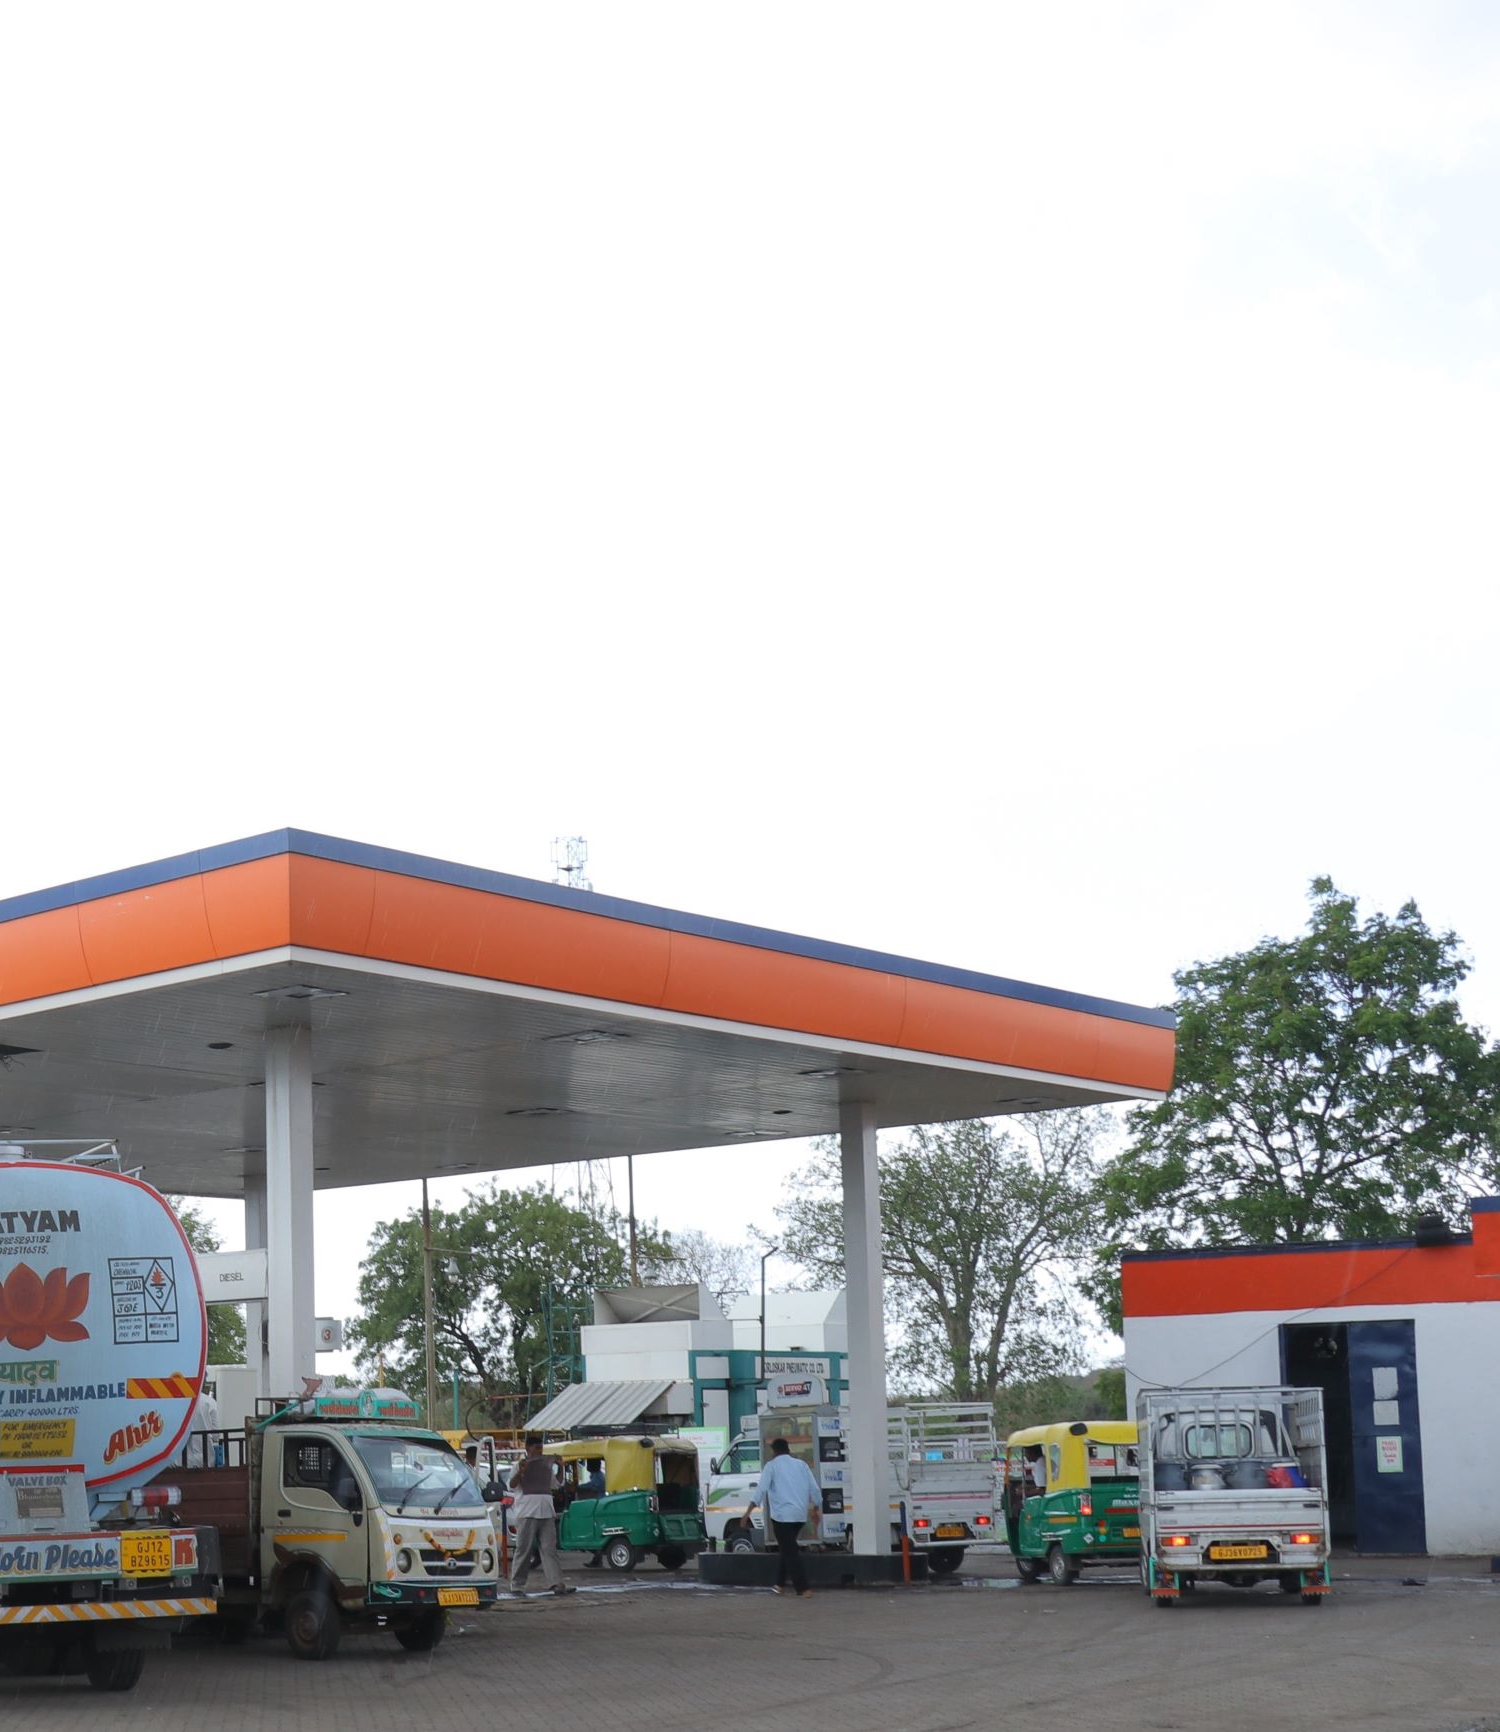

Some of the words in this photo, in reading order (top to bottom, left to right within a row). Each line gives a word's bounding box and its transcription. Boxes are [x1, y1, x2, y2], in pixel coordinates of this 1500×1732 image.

[219, 1272, 244, 1282] DIESEL
[126, 1280, 141, 1291] 1203
[155, 1287, 164, 1299] 3
[323, 1329, 331, 1340] 3
[10, 1382, 126, 1405] INFLAMMABLE
[8, 1476, 44, 1487] VALVE
[46, 1475, 68, 1486] BOX
[137, 1541, 162, 1553] GJ12
[45, 1543, 119, 1572] Please
[130, 1554, 170, 1568] BZ9615
